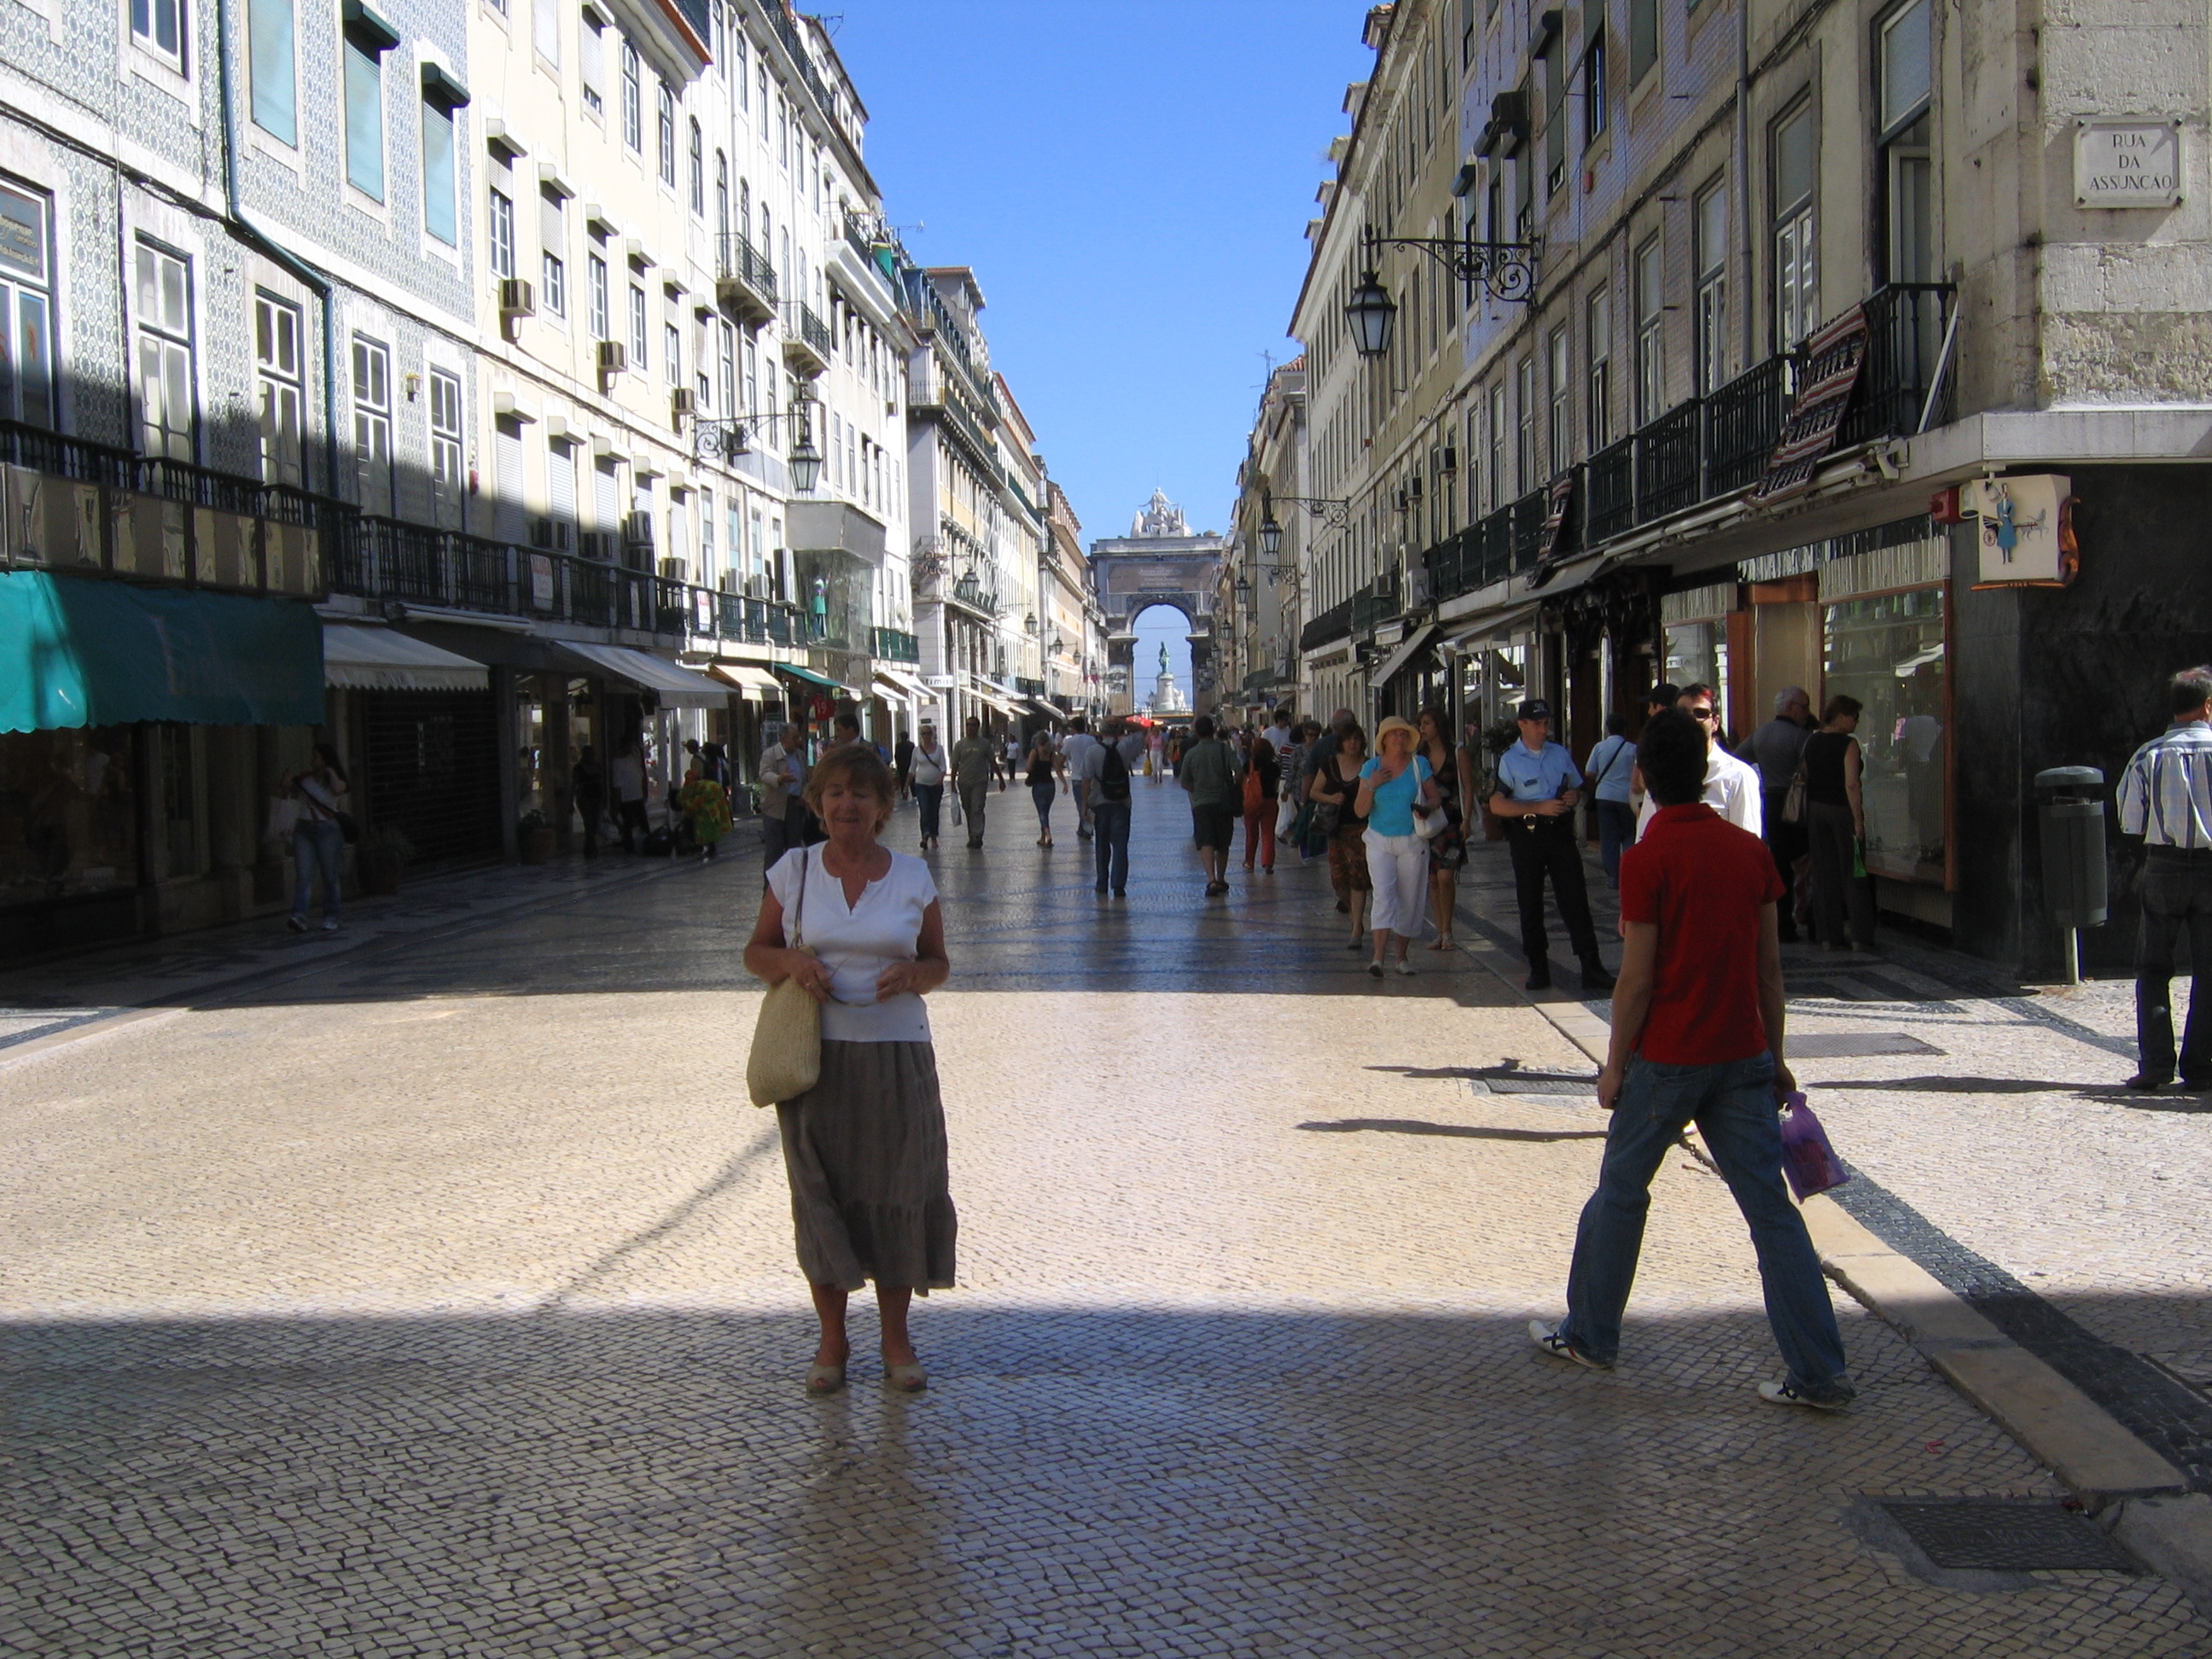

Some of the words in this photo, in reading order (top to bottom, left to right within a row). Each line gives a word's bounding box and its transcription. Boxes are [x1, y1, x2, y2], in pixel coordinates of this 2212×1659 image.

[2113, 134, 2145, 148] RUA
[2118, 154, 2140, 168] DA
[2089, 173, 2172, 190] ASSUNÇÃO
